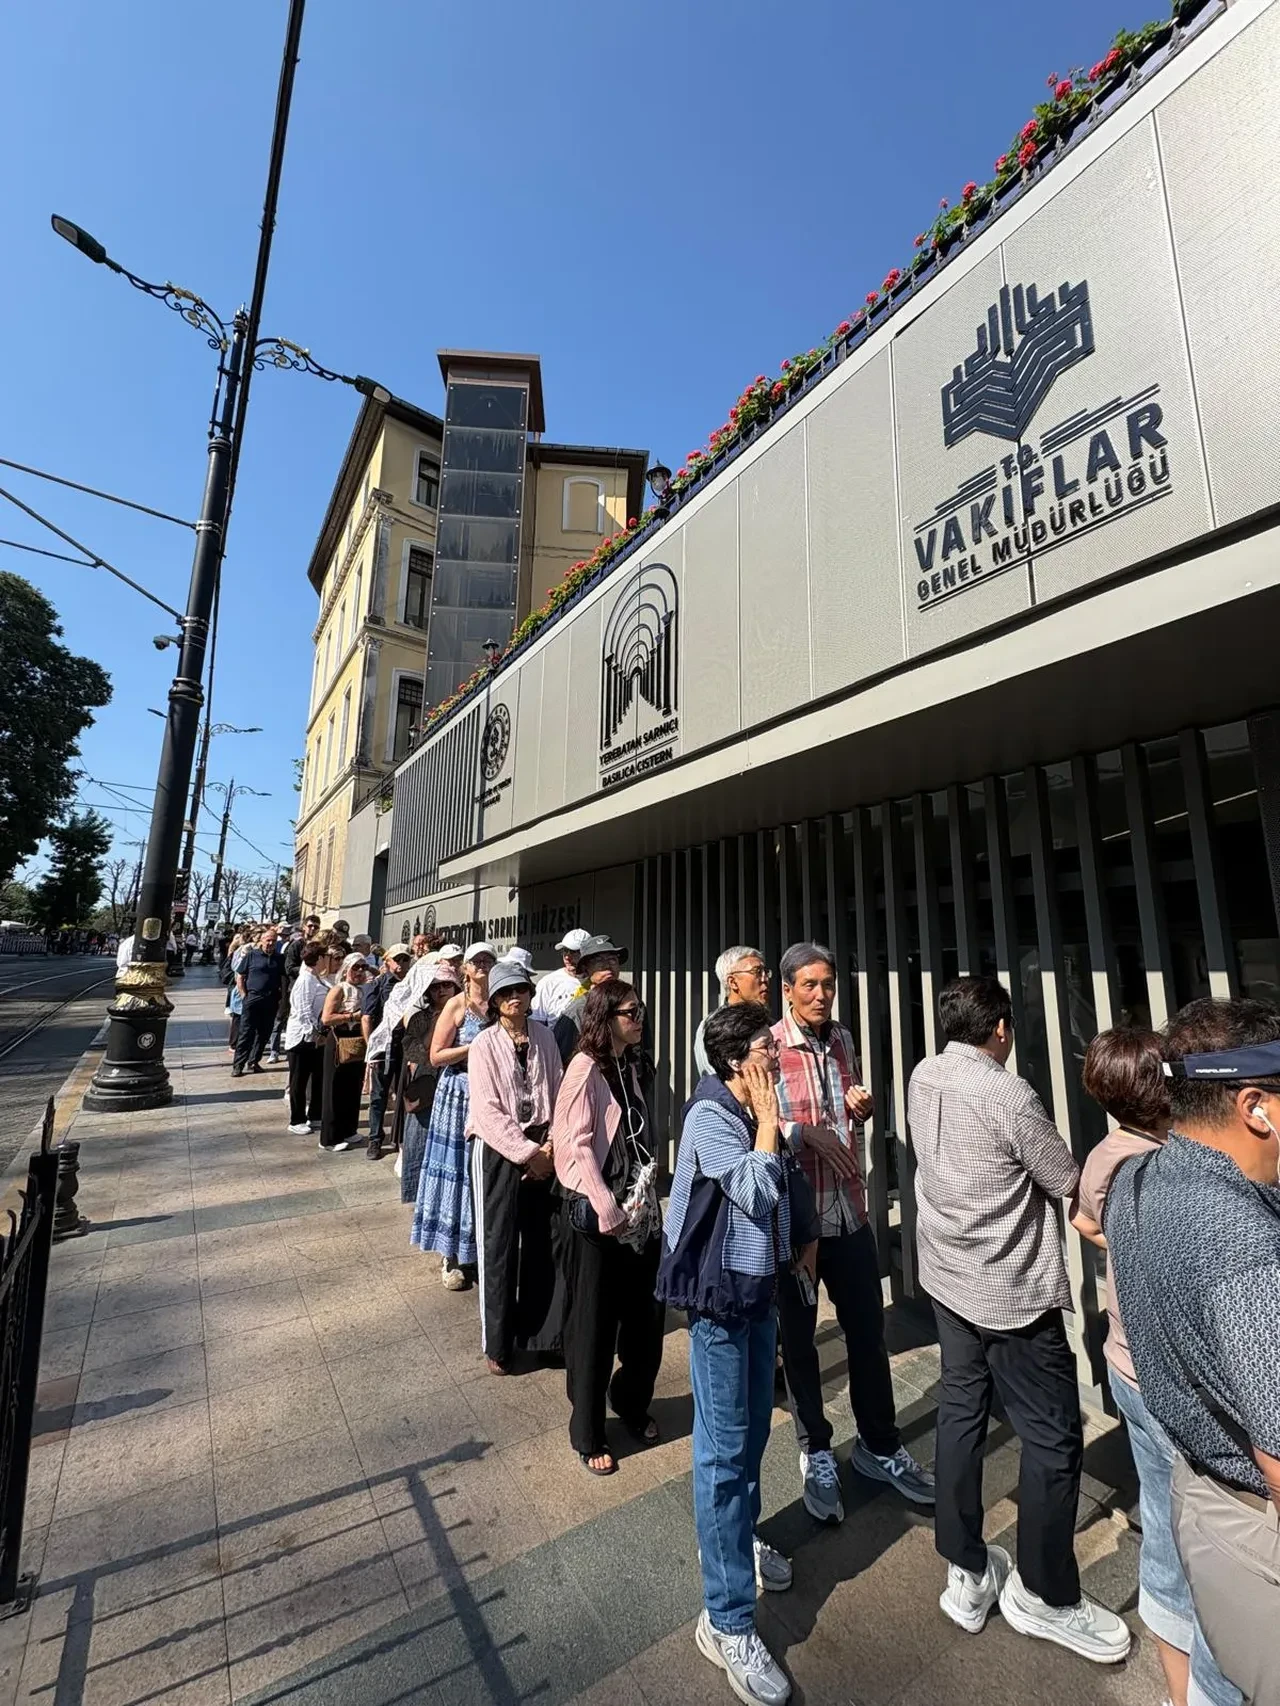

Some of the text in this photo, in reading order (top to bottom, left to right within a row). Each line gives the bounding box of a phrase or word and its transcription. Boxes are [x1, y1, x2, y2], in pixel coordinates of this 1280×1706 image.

[914, 402, 1169, 573] VAKIFLAR
[917, 449, 1170, 600] GENEL MÜDÜRLÜĞÜ
[599, 735, 643, 767] YEREBATAN
[636, 747, 673, 773] CISTERN
[488, 911, 528, 940] SARNICI
